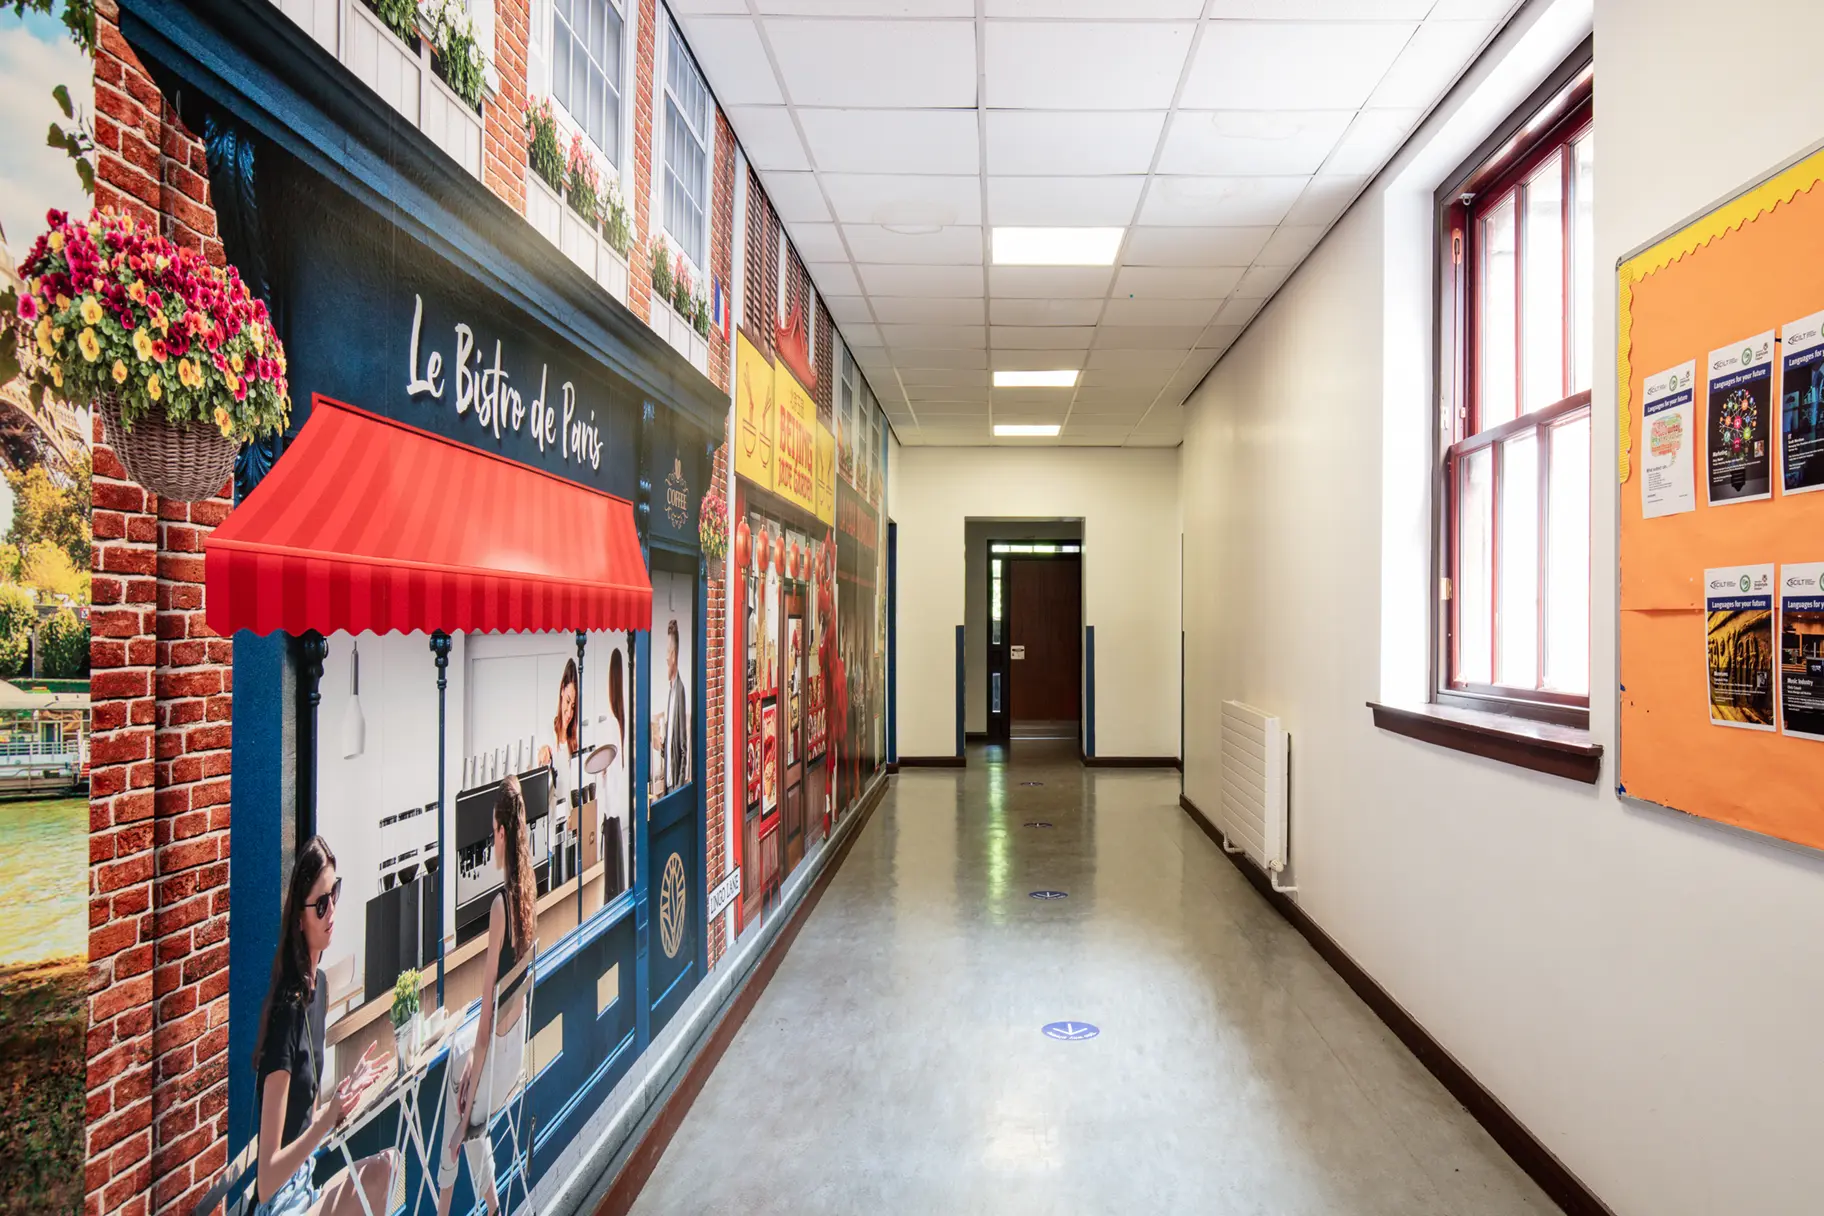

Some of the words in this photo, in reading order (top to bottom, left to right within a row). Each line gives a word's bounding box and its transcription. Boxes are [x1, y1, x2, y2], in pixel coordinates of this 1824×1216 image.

[1788, 353, 1814, 366] Languages
[1814, 350, 1822, 358] for
[407, 294, 445, 398] Le
[455, 323, 525, 439] Bistro
[531, 363, 556, 452] de
[562, 381, 603, 470] Paris
[1713, 378, 1735, 389] Languages
[1741, 373, 1752, 383] your
[1752, 369, 1766, 378] future
[666, 487, 687, 511] COFFEE
[1711, 601, 1734, 610] Languages
[1741, 601, 1752, 609] your
[1752, 599, 1766, 607] future
[1787, 601, 1813, 610] Languages
[726, 874, 739, 898] LANE
